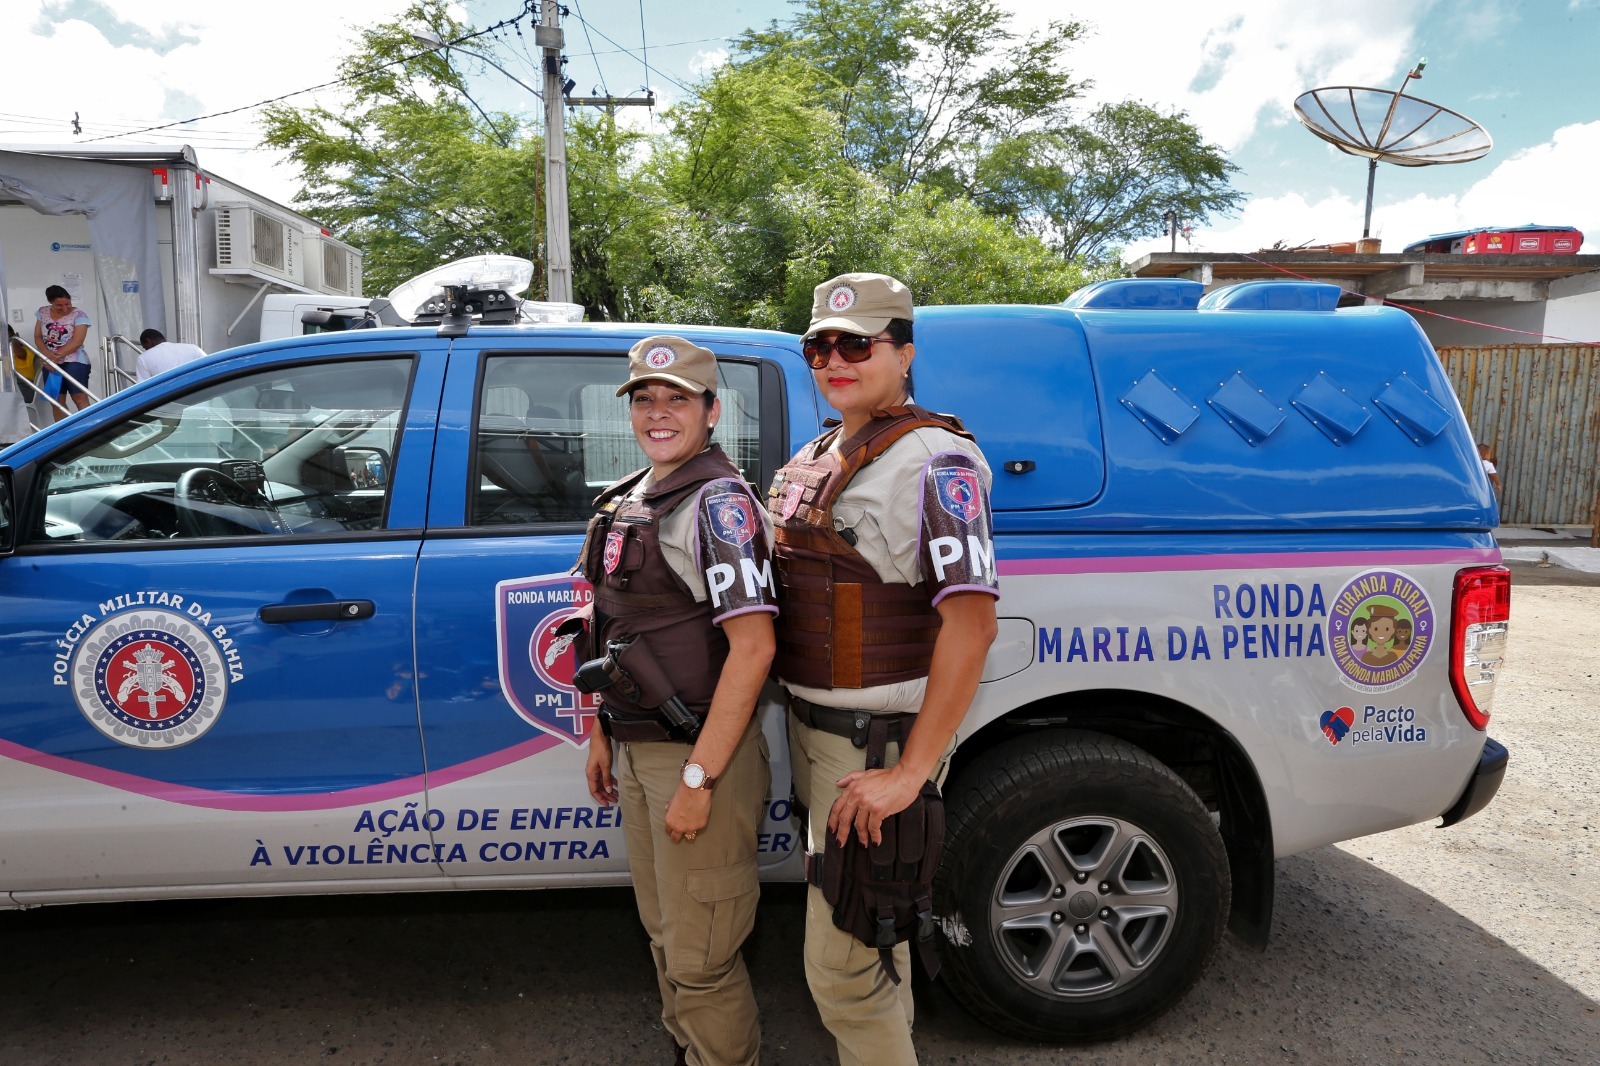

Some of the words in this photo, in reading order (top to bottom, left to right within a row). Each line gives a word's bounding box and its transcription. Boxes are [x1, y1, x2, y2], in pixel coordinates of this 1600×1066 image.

[929, 535, 998, 582] PM
[508, 591, 545, 604] RONDA
[547, 590, 582, 603] MARIA
[584, 590, 594, 602] D
[706, 558, 776, 608] PM
[1214, 583, 1326, 619] RONDA
[1336, 575, 1387, 617] CIRANDA
[1392, 578, 1429, 618] RURAL
[54, 614, 96, 686] POLÍCIA
[98, 591, 184, 616] MILITAR
[187, 602, 212, 626] DA
[212, 625, 244, 684] BAHIA
[1038, 626, 1154, 663] MARIA
[1168, 625, 1212, 661] DA
[1223, 624, 1326, 659] PENHA
[1334, 635, 1345, 658] COM
[1344, 660, 1372, 682] RONDA
[1372, 669, 1400, 684] MARIA
[1400, 660, 1413, 674] DA
[1407, 636, 1428, 665] PENHA
[536, 694, 562, 706] PM
[1364, 704, 1415, 723] Pacto
[354, 806, 448, 837] AÇÃO
[457, 809, 499, 831] DE
[249, 839, 273, 866] À
[284, 839, 468, 865] VIOLÊNCIA
[479, 840, 609, 862] CONTRA
